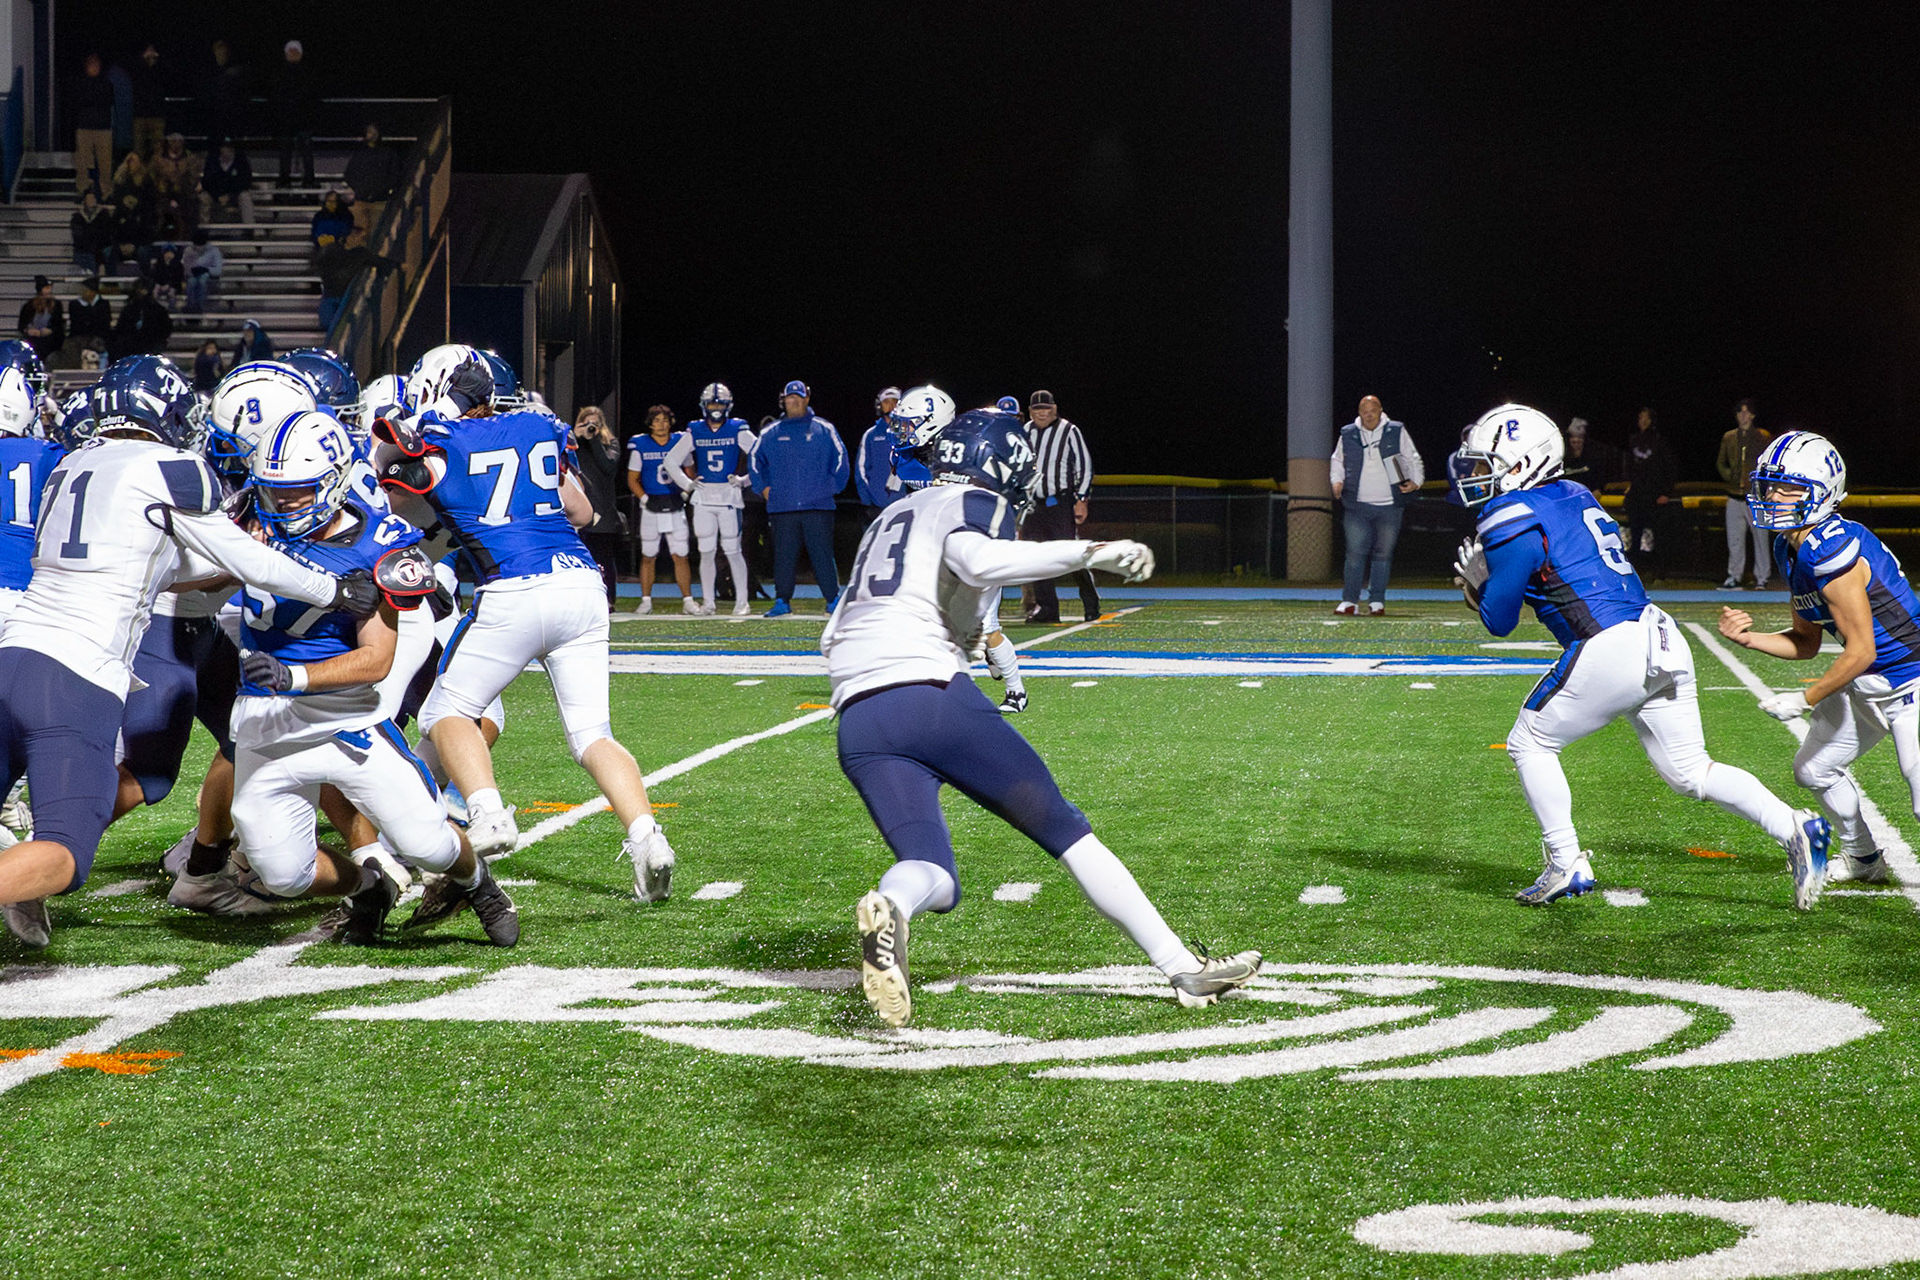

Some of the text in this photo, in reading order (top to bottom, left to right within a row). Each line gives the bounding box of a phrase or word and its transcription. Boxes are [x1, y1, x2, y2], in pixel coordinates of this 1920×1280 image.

[246, 398, 263, 425] 9
[925, 398, 935, 413] 3
[318, 430, 346, 464] 57
[707, 450, 724, 472] 5
[939, 440, 965, 464] 33
[1825, 449, 1842, 478] 12
[469, 440, 565, 526] 79
[35, 469, 94, 559] 71
[1582, 506, 1634, 576] 6
[1804, 519, 1846, 551] 12
